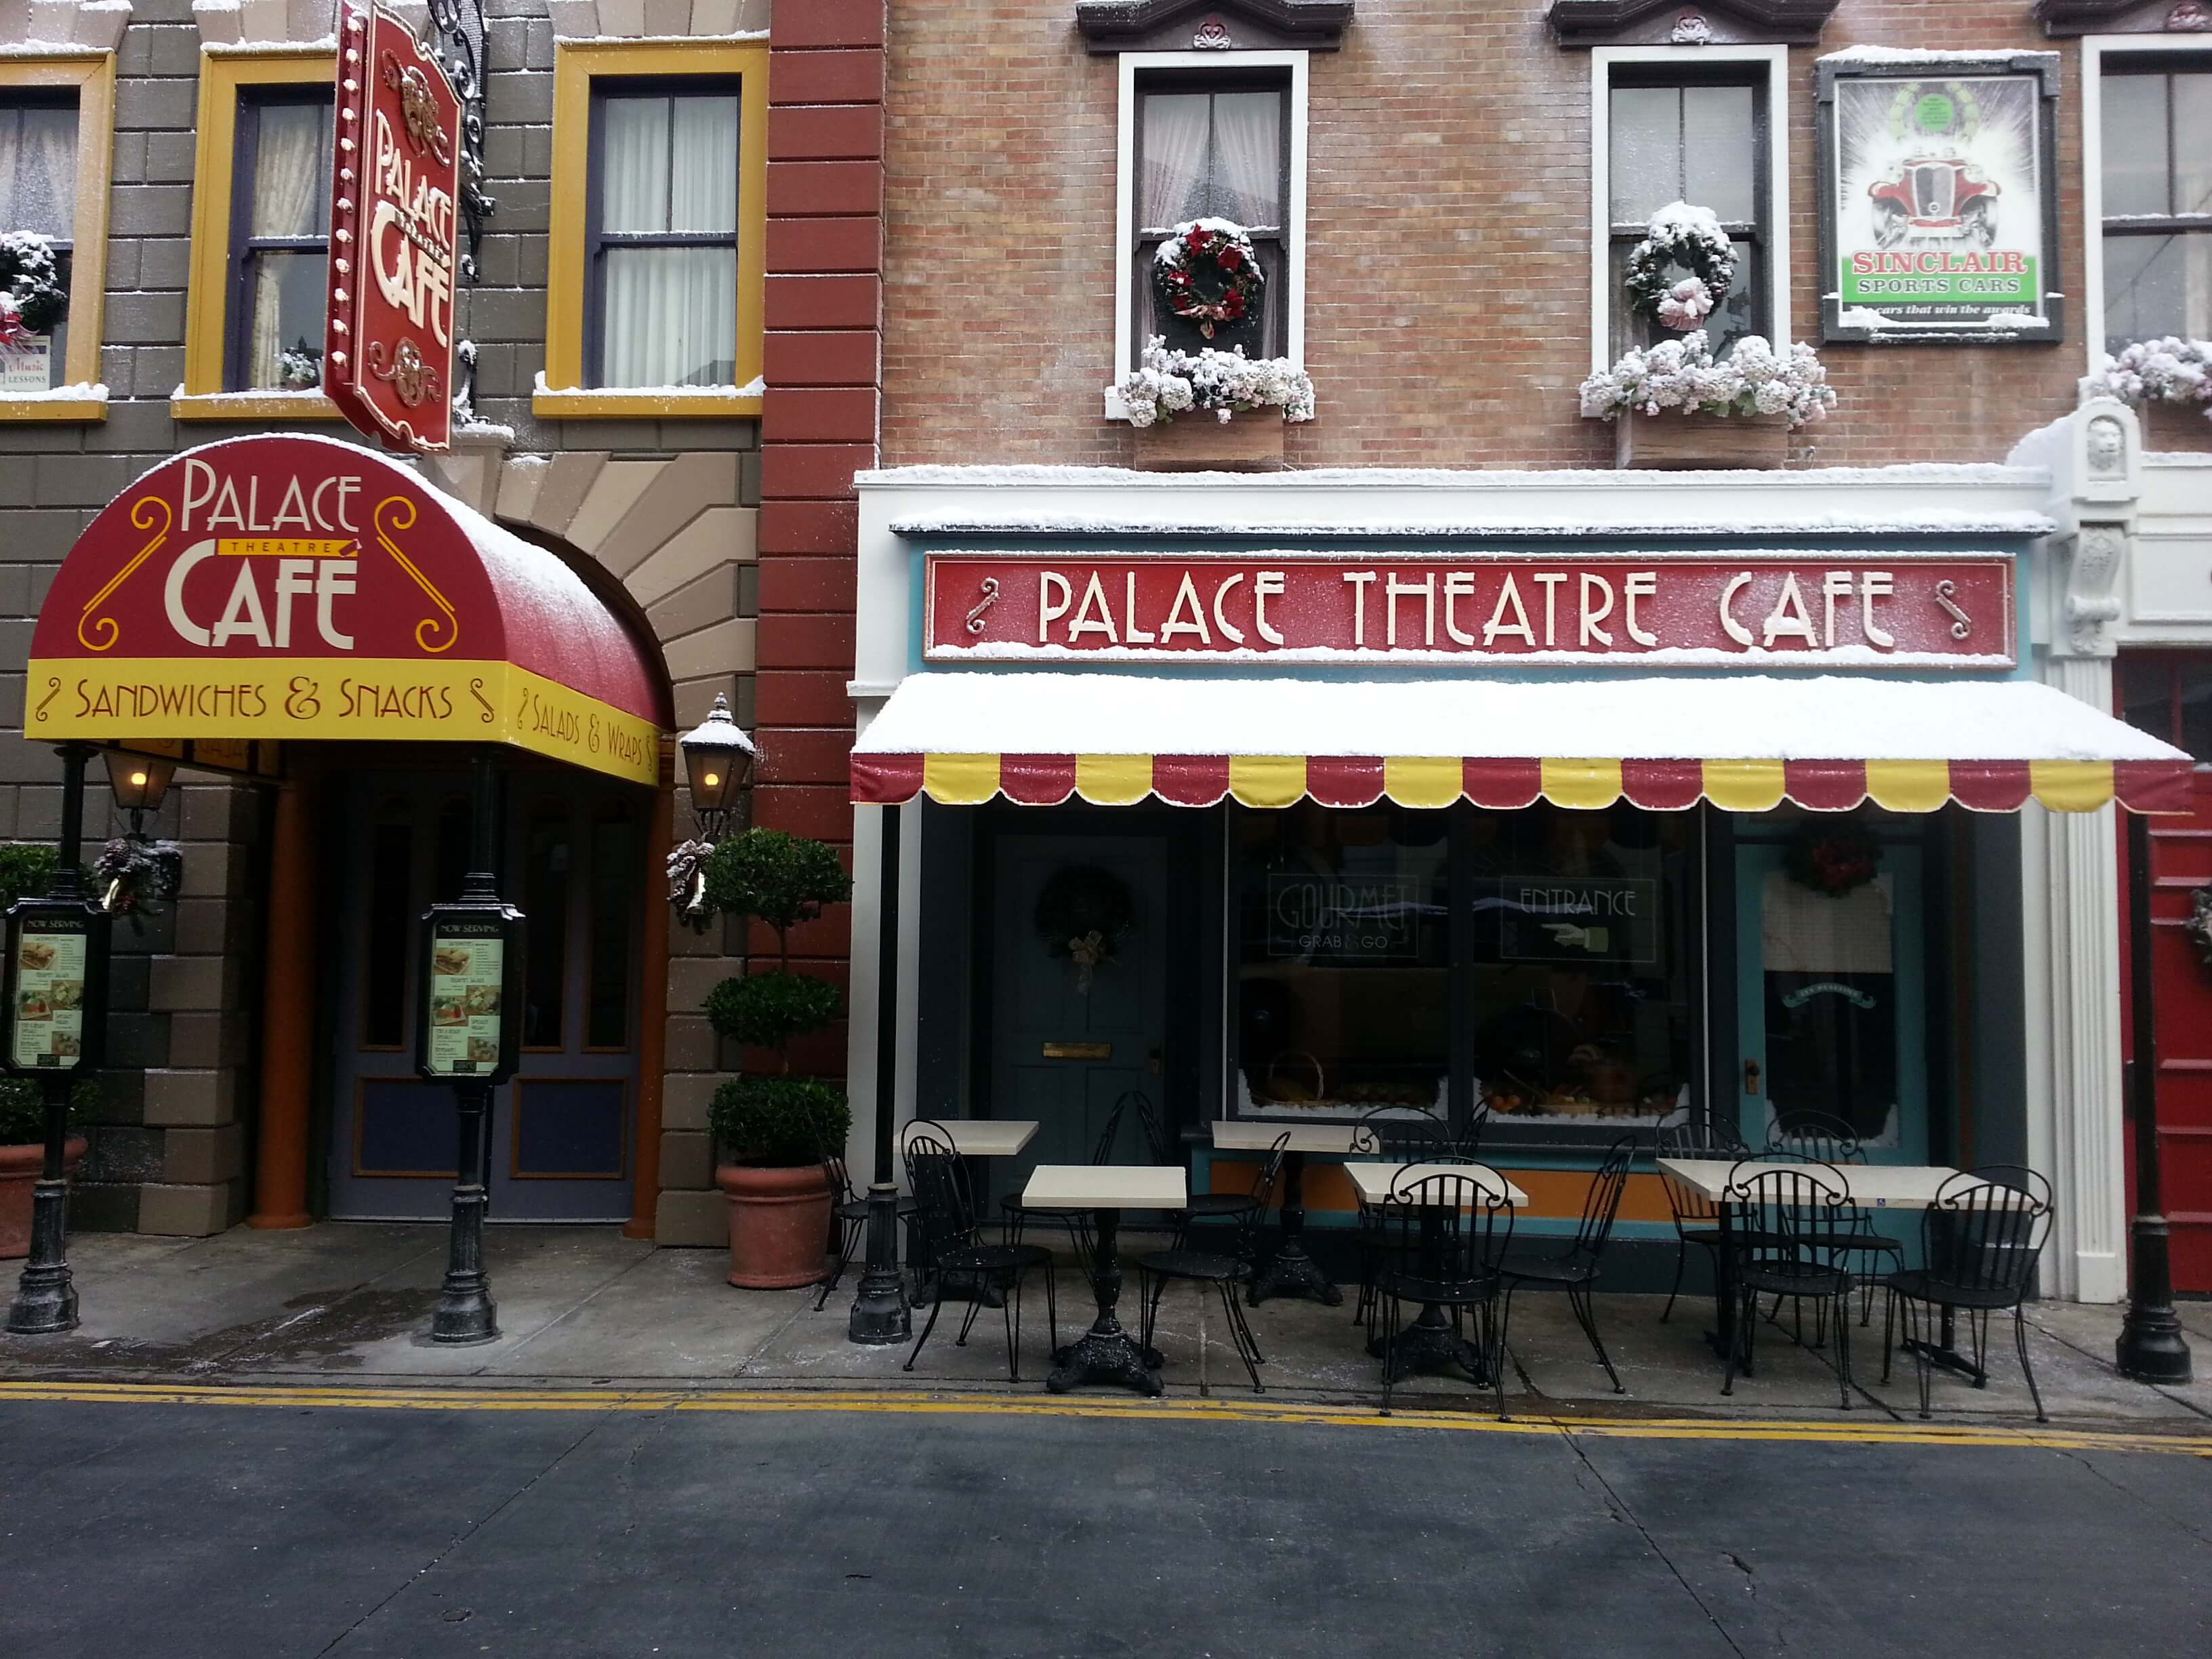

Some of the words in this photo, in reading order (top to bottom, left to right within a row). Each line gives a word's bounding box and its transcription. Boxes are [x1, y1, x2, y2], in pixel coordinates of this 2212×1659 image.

[375, 108, 451, 250] PALACE
[371, 200, 449, 348] CAFE
[1853, 251, 2028, 275] SINCLAIR
[1858, 279, 1949, 293] SPORTS
[1959, 278, 2020, 293] CARS
[1877, 306, 1903, 314] cars
[1906, 305, 1931, 314] that
[1935, 305, 1957, 314] win
[1961, 305, 1980, 314] the
[1983, 305, 2031, 314] awards
[181, 458, 361, 532] PALACE
[231, 542, 332, 554] THEATRE
[164, 539, 358, 651] CAFE
[1040, 570, 1286, 644] PALACE
[1343, 571, 1660, 647] THEATRE
[1721, 571, 1894, 647] CAFE
[75, 678, 266, 718] SANDWICHES
[285, 676, 322, 720] &
[339, 678, 453, 718] SNACKS
[532, 697, 581, 745] SALADS
[588, 714, 601, 754] &
[607, 724, 644, 764] WRAPS
[1277, 883, 1408, 930] GOURMET
[1519, 888, 1637, 917] ENTRANCE
[28, 920, 47, 928] NOW
[49, 920, 84, 928] SERVING
[441, 924, 461, 933] NOW
[463, 924, 499, 933] SERVING
[1299, 935, 1342, 949] GRAB
[1361, 935, 1388, 949] GO
